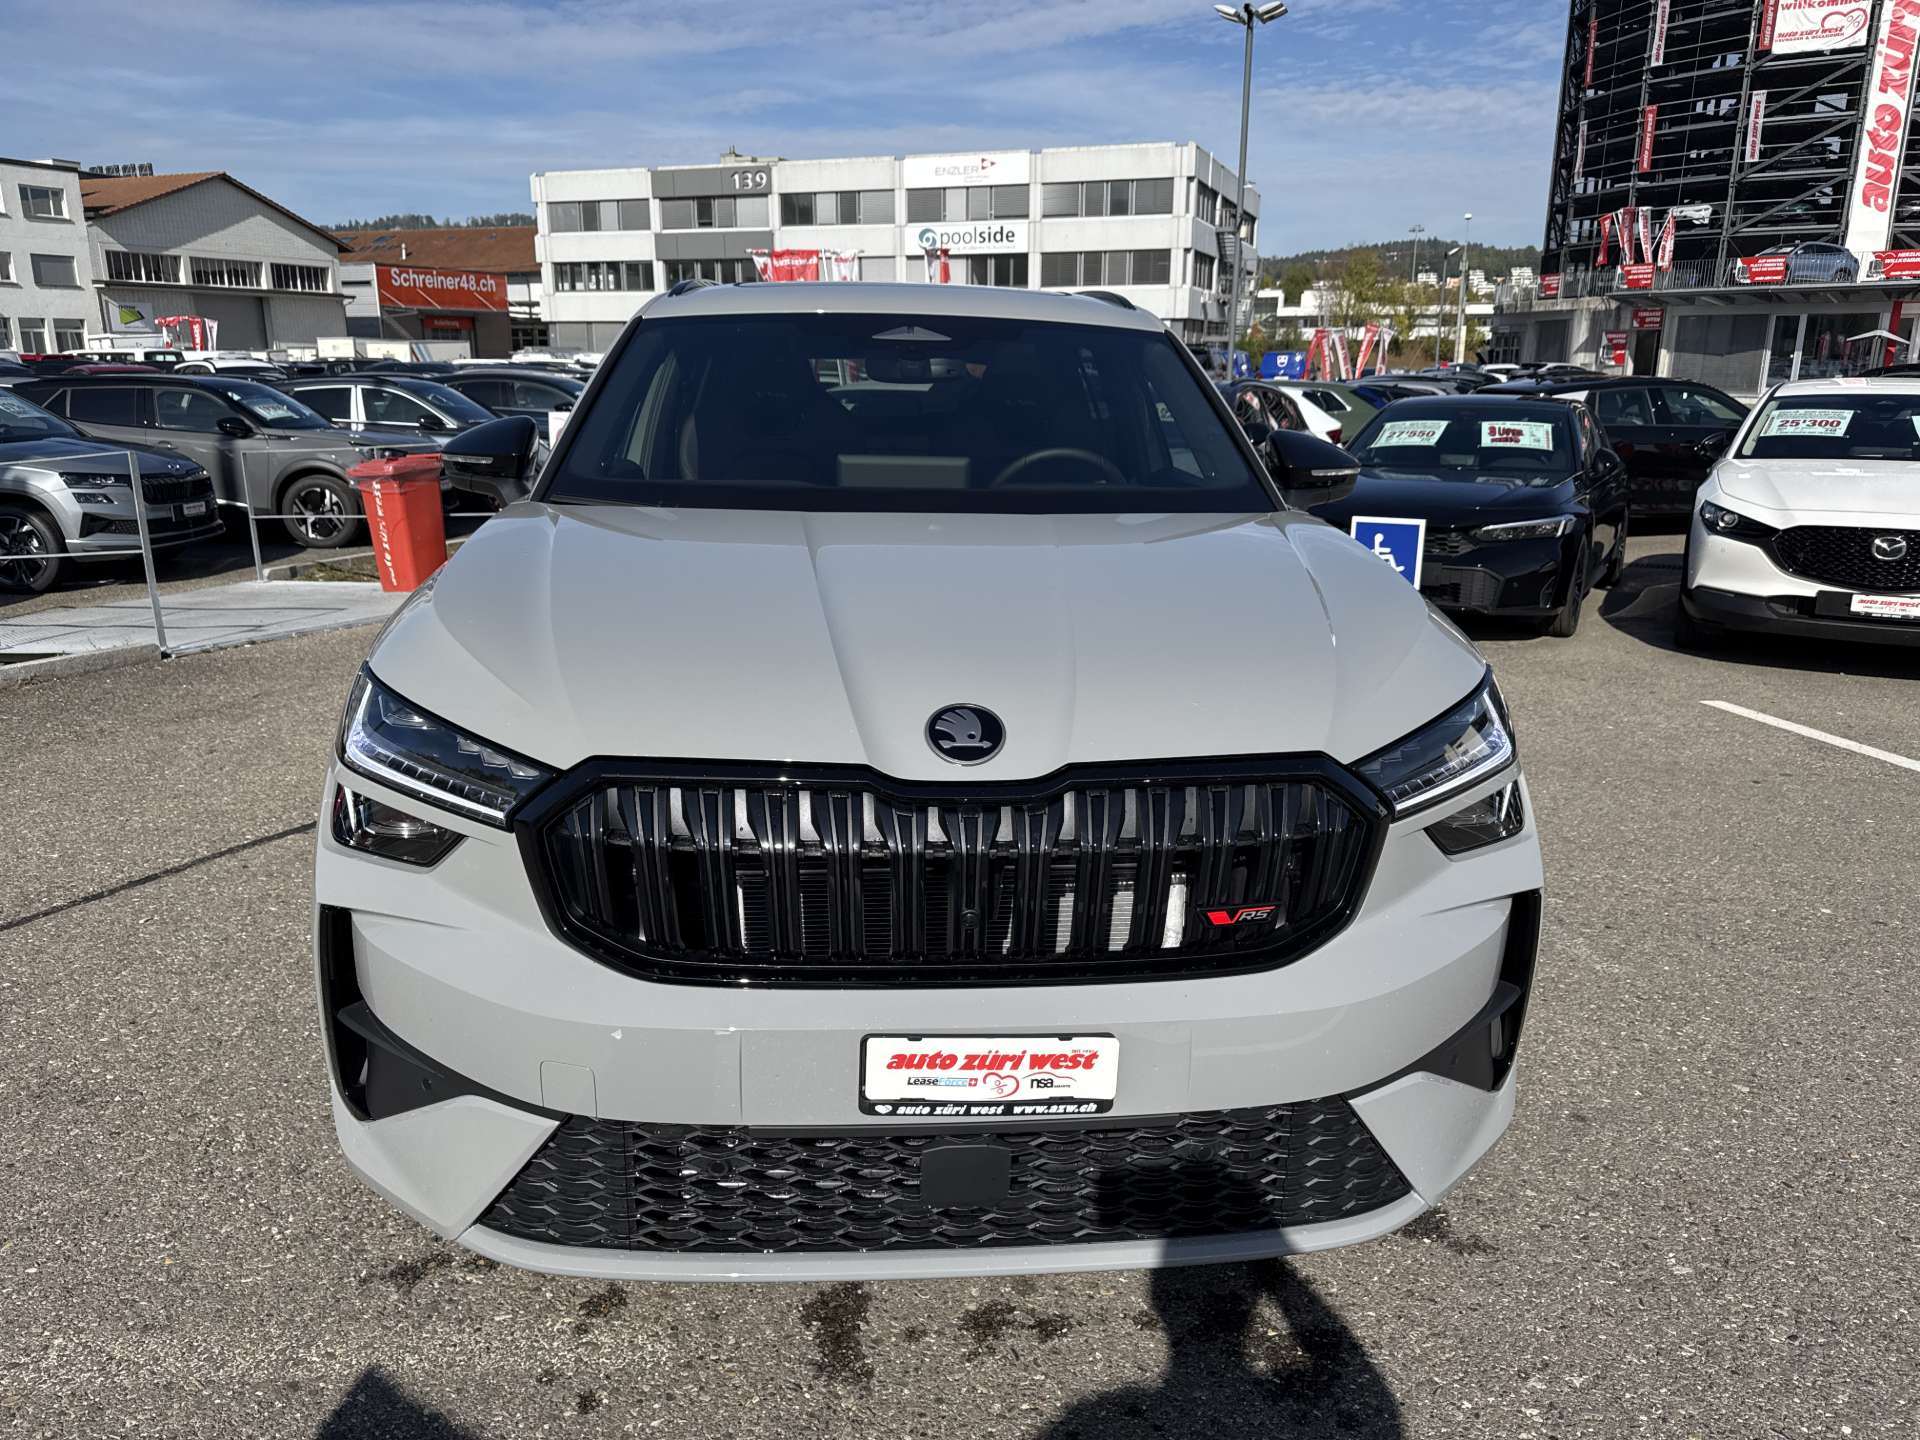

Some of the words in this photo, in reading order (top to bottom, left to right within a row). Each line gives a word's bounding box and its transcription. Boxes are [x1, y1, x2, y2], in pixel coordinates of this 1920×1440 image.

[1862, 103, 1902, 212] auto
[935, 165, 979, 176] ENZLER
[731, 171, 768, 190] 139
[940, 225, 1015, 248] poolside
[391, 267, 497, 293] Schreiner48.ch
[1777, 419, 1842, 428] 25'300
[886, 1051, 959, 1070] auto
[959, 1050, 1027, 1071] züri
[1029, 1051, 1100, 1070] west
[1030, 1076, 1054, 1089] nsa
[896, 1105, 931, 1115] auto
[933, 1104, 967, 1115] züri
[970, 1104, 1005, 1115] west
[1013, 1103, 1098, 1115] www.azw.ch
